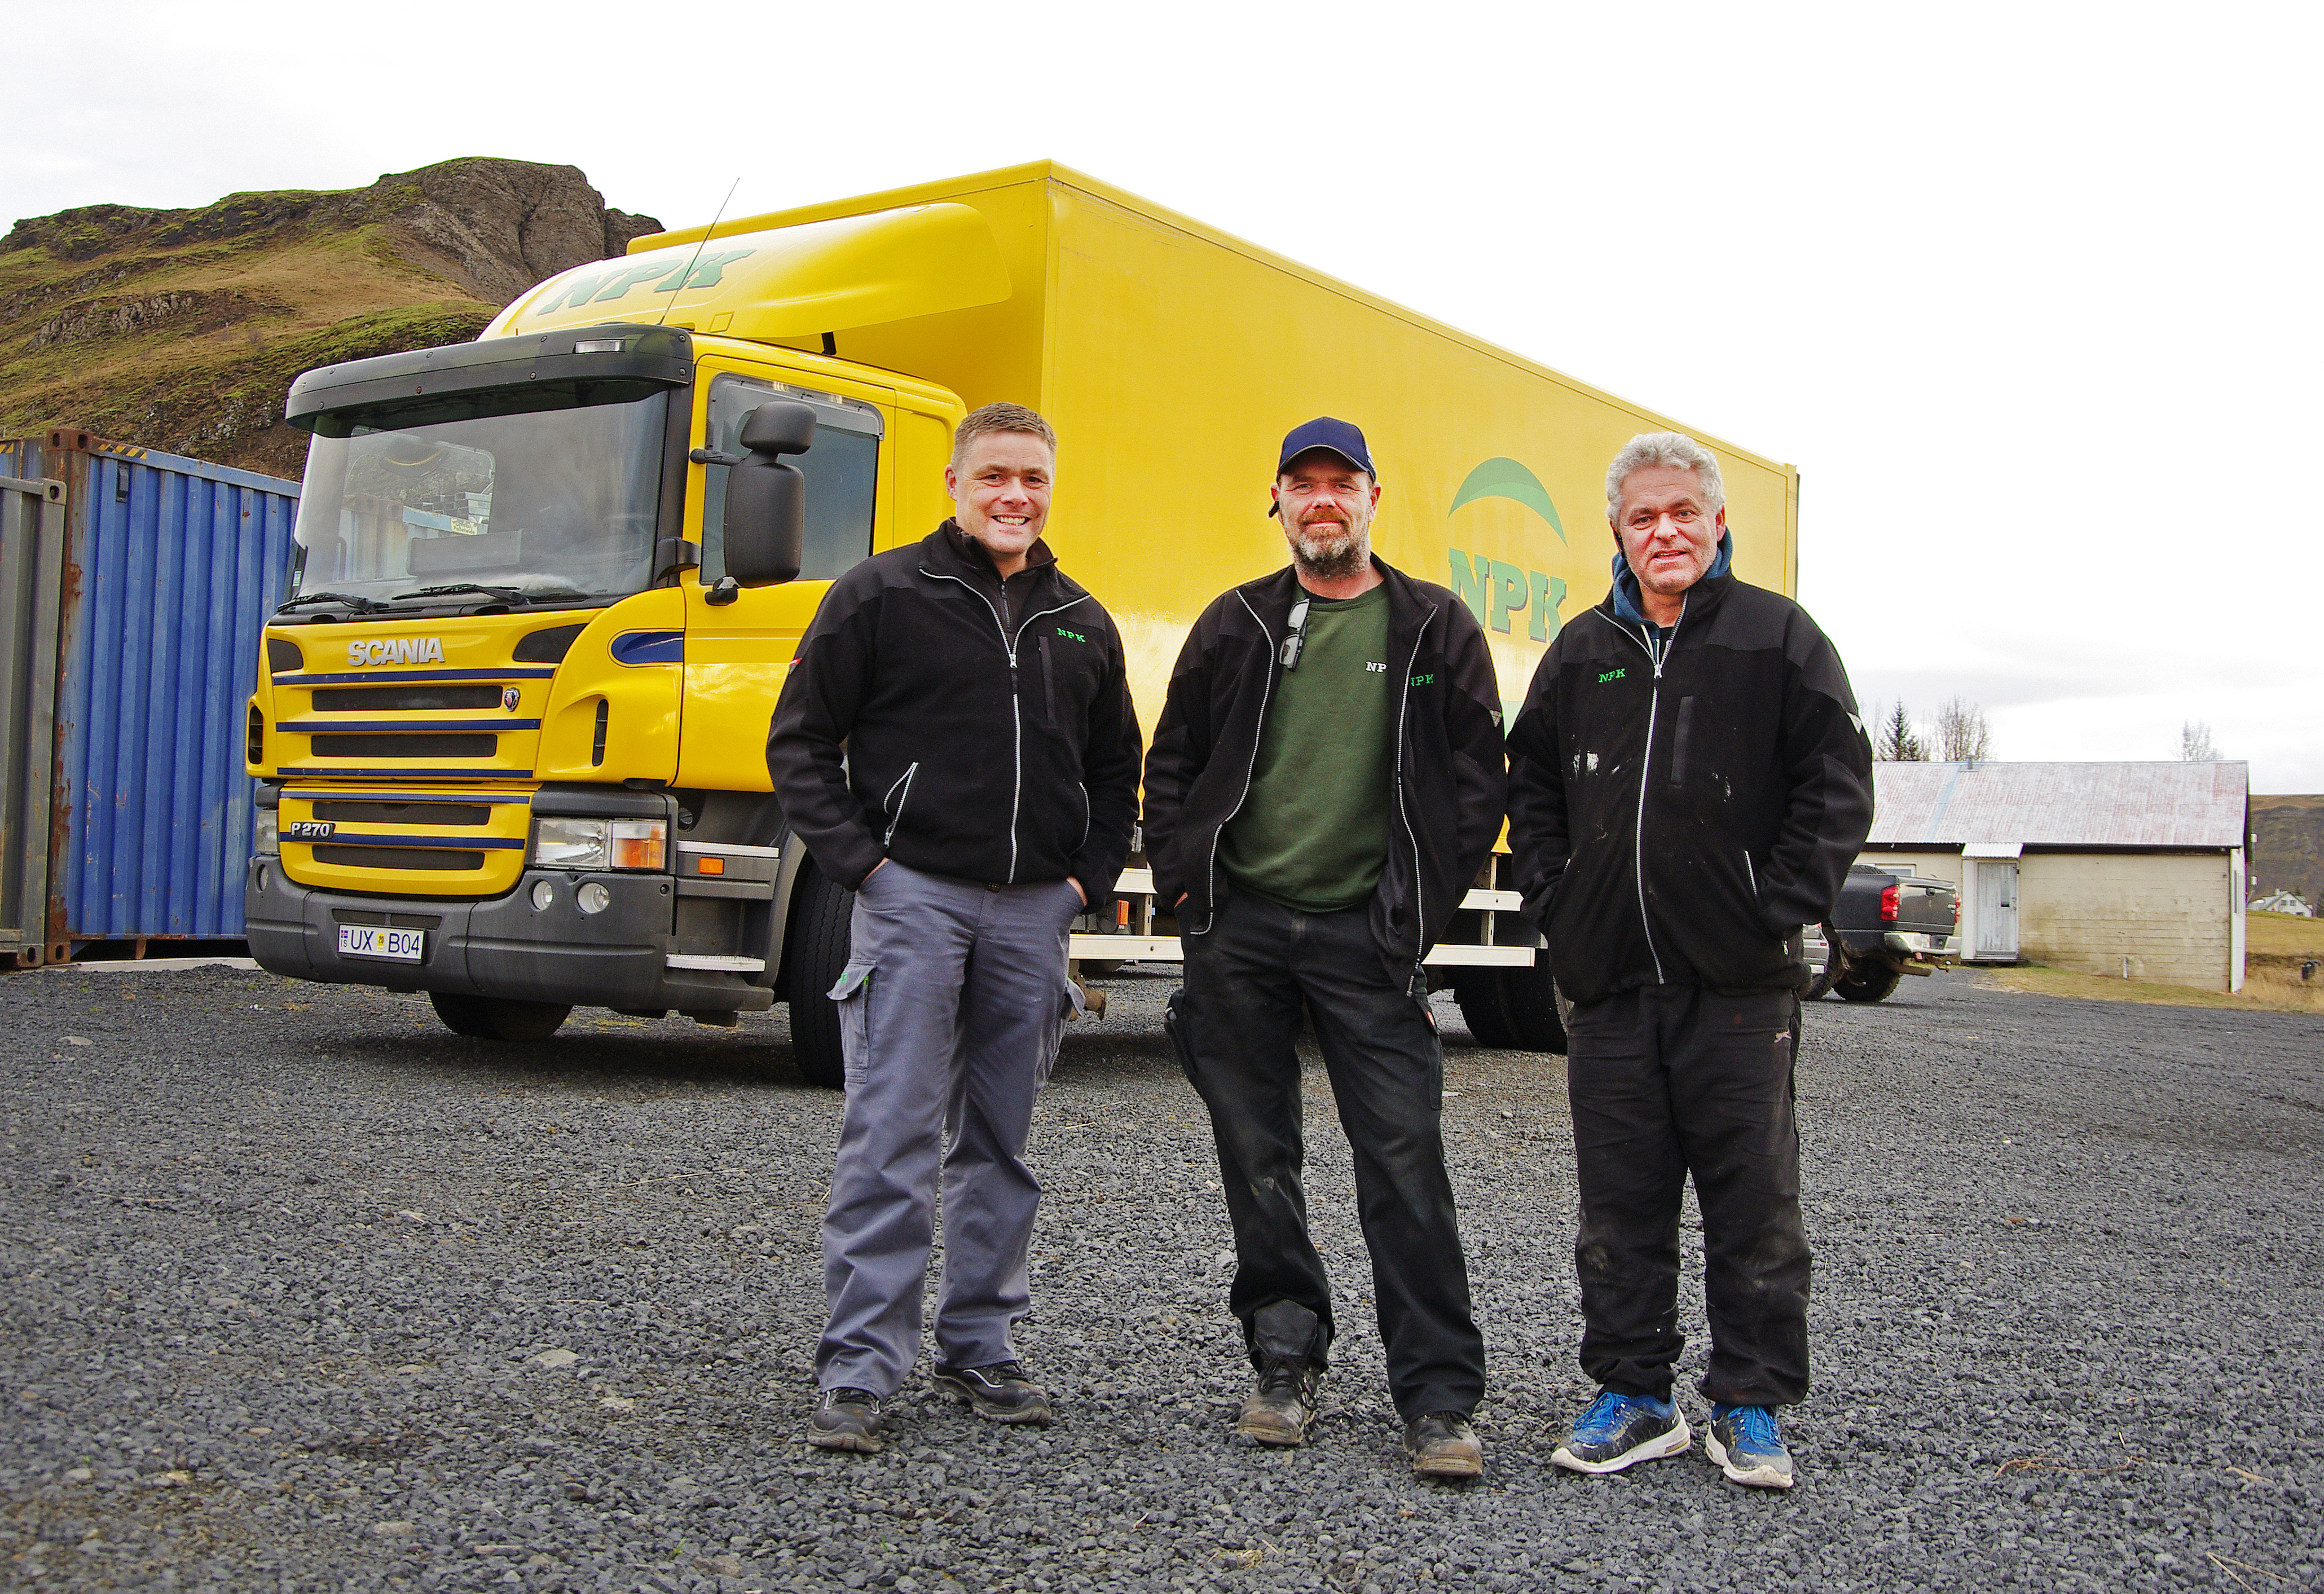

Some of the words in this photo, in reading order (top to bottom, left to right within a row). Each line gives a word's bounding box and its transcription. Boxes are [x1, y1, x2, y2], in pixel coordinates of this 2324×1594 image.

[537, 249, 756, 316] NPK
[1448, 547, 1567, 644] NPK
[1057, 627, 1086, 642] NPK
[347, 637, 446, 667] SCANIA
[1365, 661, 1387, 672] NP
[1598, 668, 1626, 683] NPK
[351, 930, 374, 951] UX
